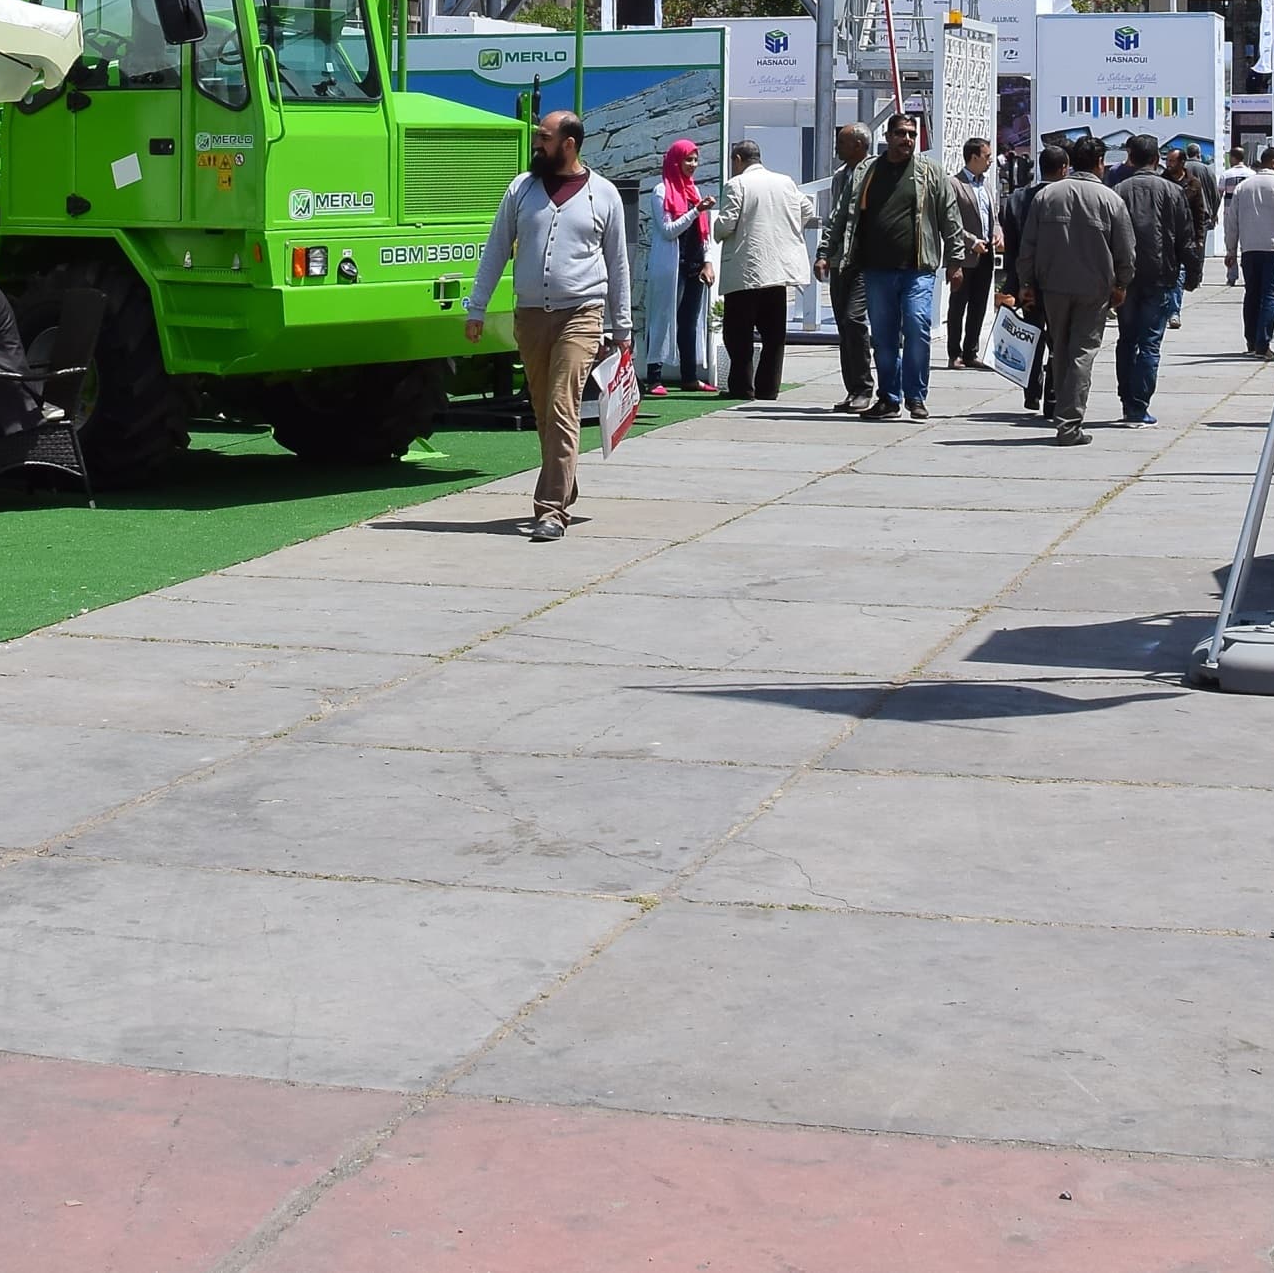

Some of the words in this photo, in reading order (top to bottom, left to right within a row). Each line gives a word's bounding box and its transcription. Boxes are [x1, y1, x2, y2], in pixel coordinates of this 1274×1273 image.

[505, 52, 567, 62] MERLO
[1106, 56, 1148, 64] HASNAOUI
[212, 135, 253, 145] MERLO
[315, 193, 374, 207] MERLO
[380, 248, 424, 263] DBM
[427, 245, 476, 261] 3500
